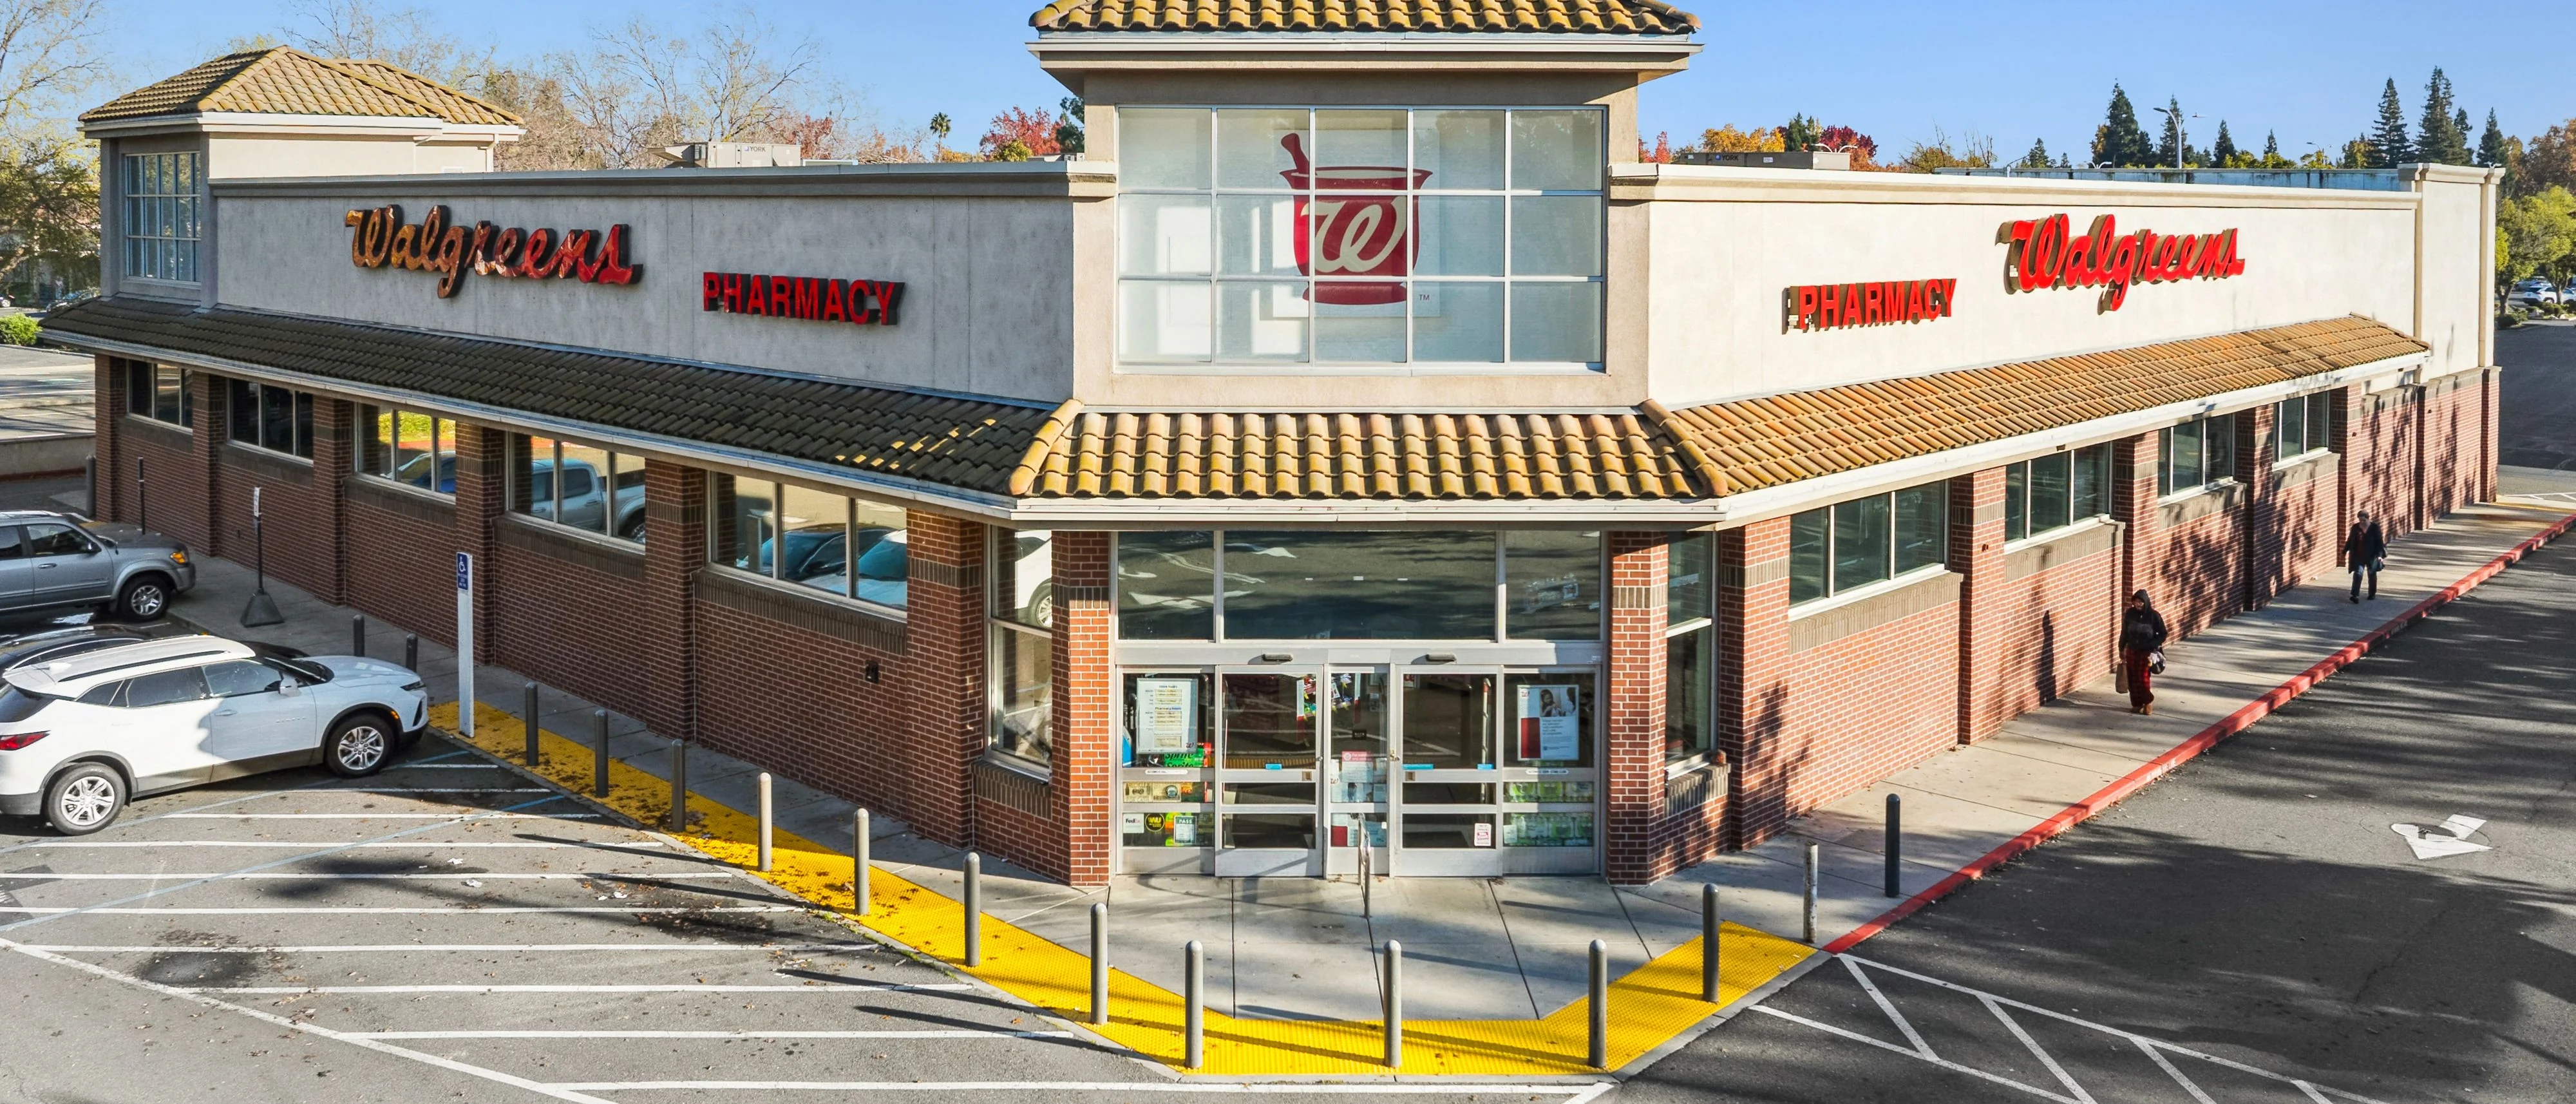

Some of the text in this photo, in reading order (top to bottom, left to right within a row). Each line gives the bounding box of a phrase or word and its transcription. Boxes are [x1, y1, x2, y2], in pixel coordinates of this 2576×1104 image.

[345, 205, 635, 298] Walgreens
[2010, 213, 2245, 312] Walgreens
[703, 272, 897, 325] PHARMACY
[1799, 278, 1957, 330] PHARMACY
